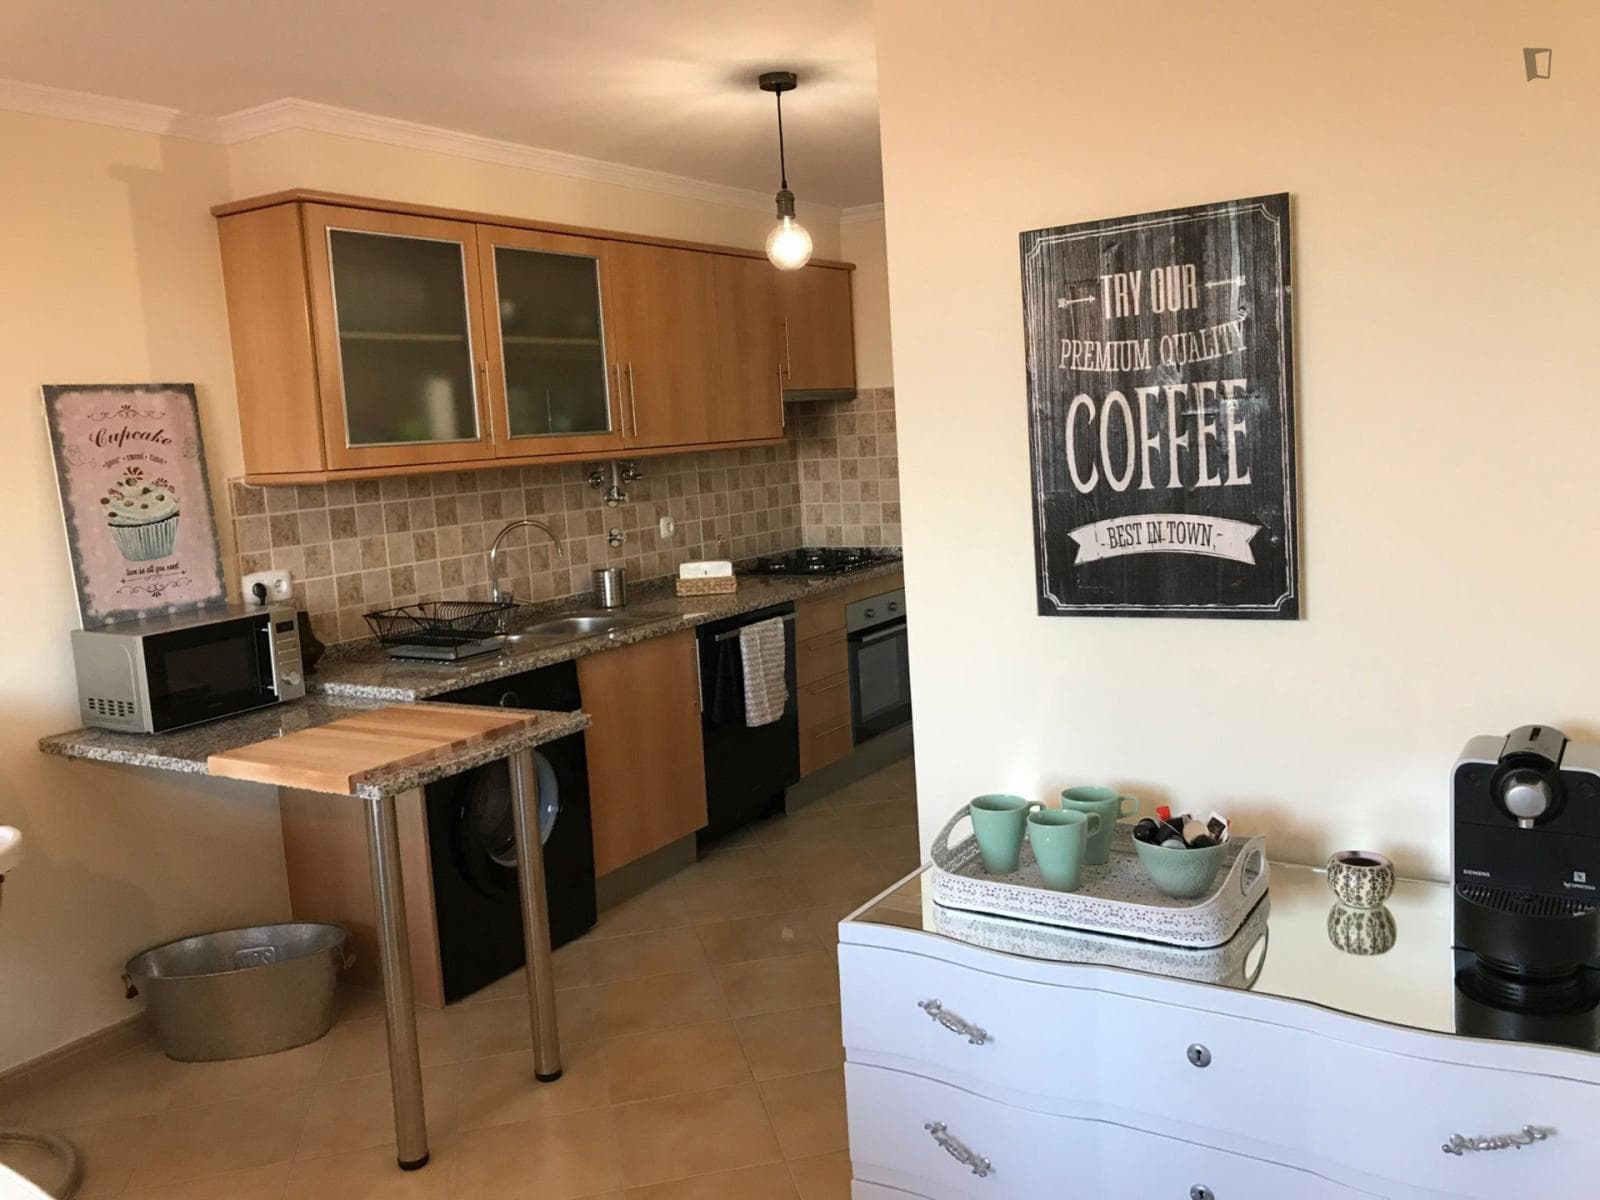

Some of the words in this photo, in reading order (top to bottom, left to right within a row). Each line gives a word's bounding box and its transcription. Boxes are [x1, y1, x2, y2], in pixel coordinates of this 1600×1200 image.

[1100, 269, 1142, 320] TRY
[1151, 263, 1198, 314] OUR
[1059, 338, 1152, 372] PREMIUM
[1159, 317, 1247, 367] QUALITY
[89, 425, 172, 448] Cupcake
[1065, 378, 1252, 494] COFFEE
[1106, 522, 1142, 549] BEST
[1146, 521, 1162, 544] IN
[1166, 520, 1214, 547] TOWN
[146, 564, 154, 574] all
[1463, 869, 1490, 877] SIEMENS
